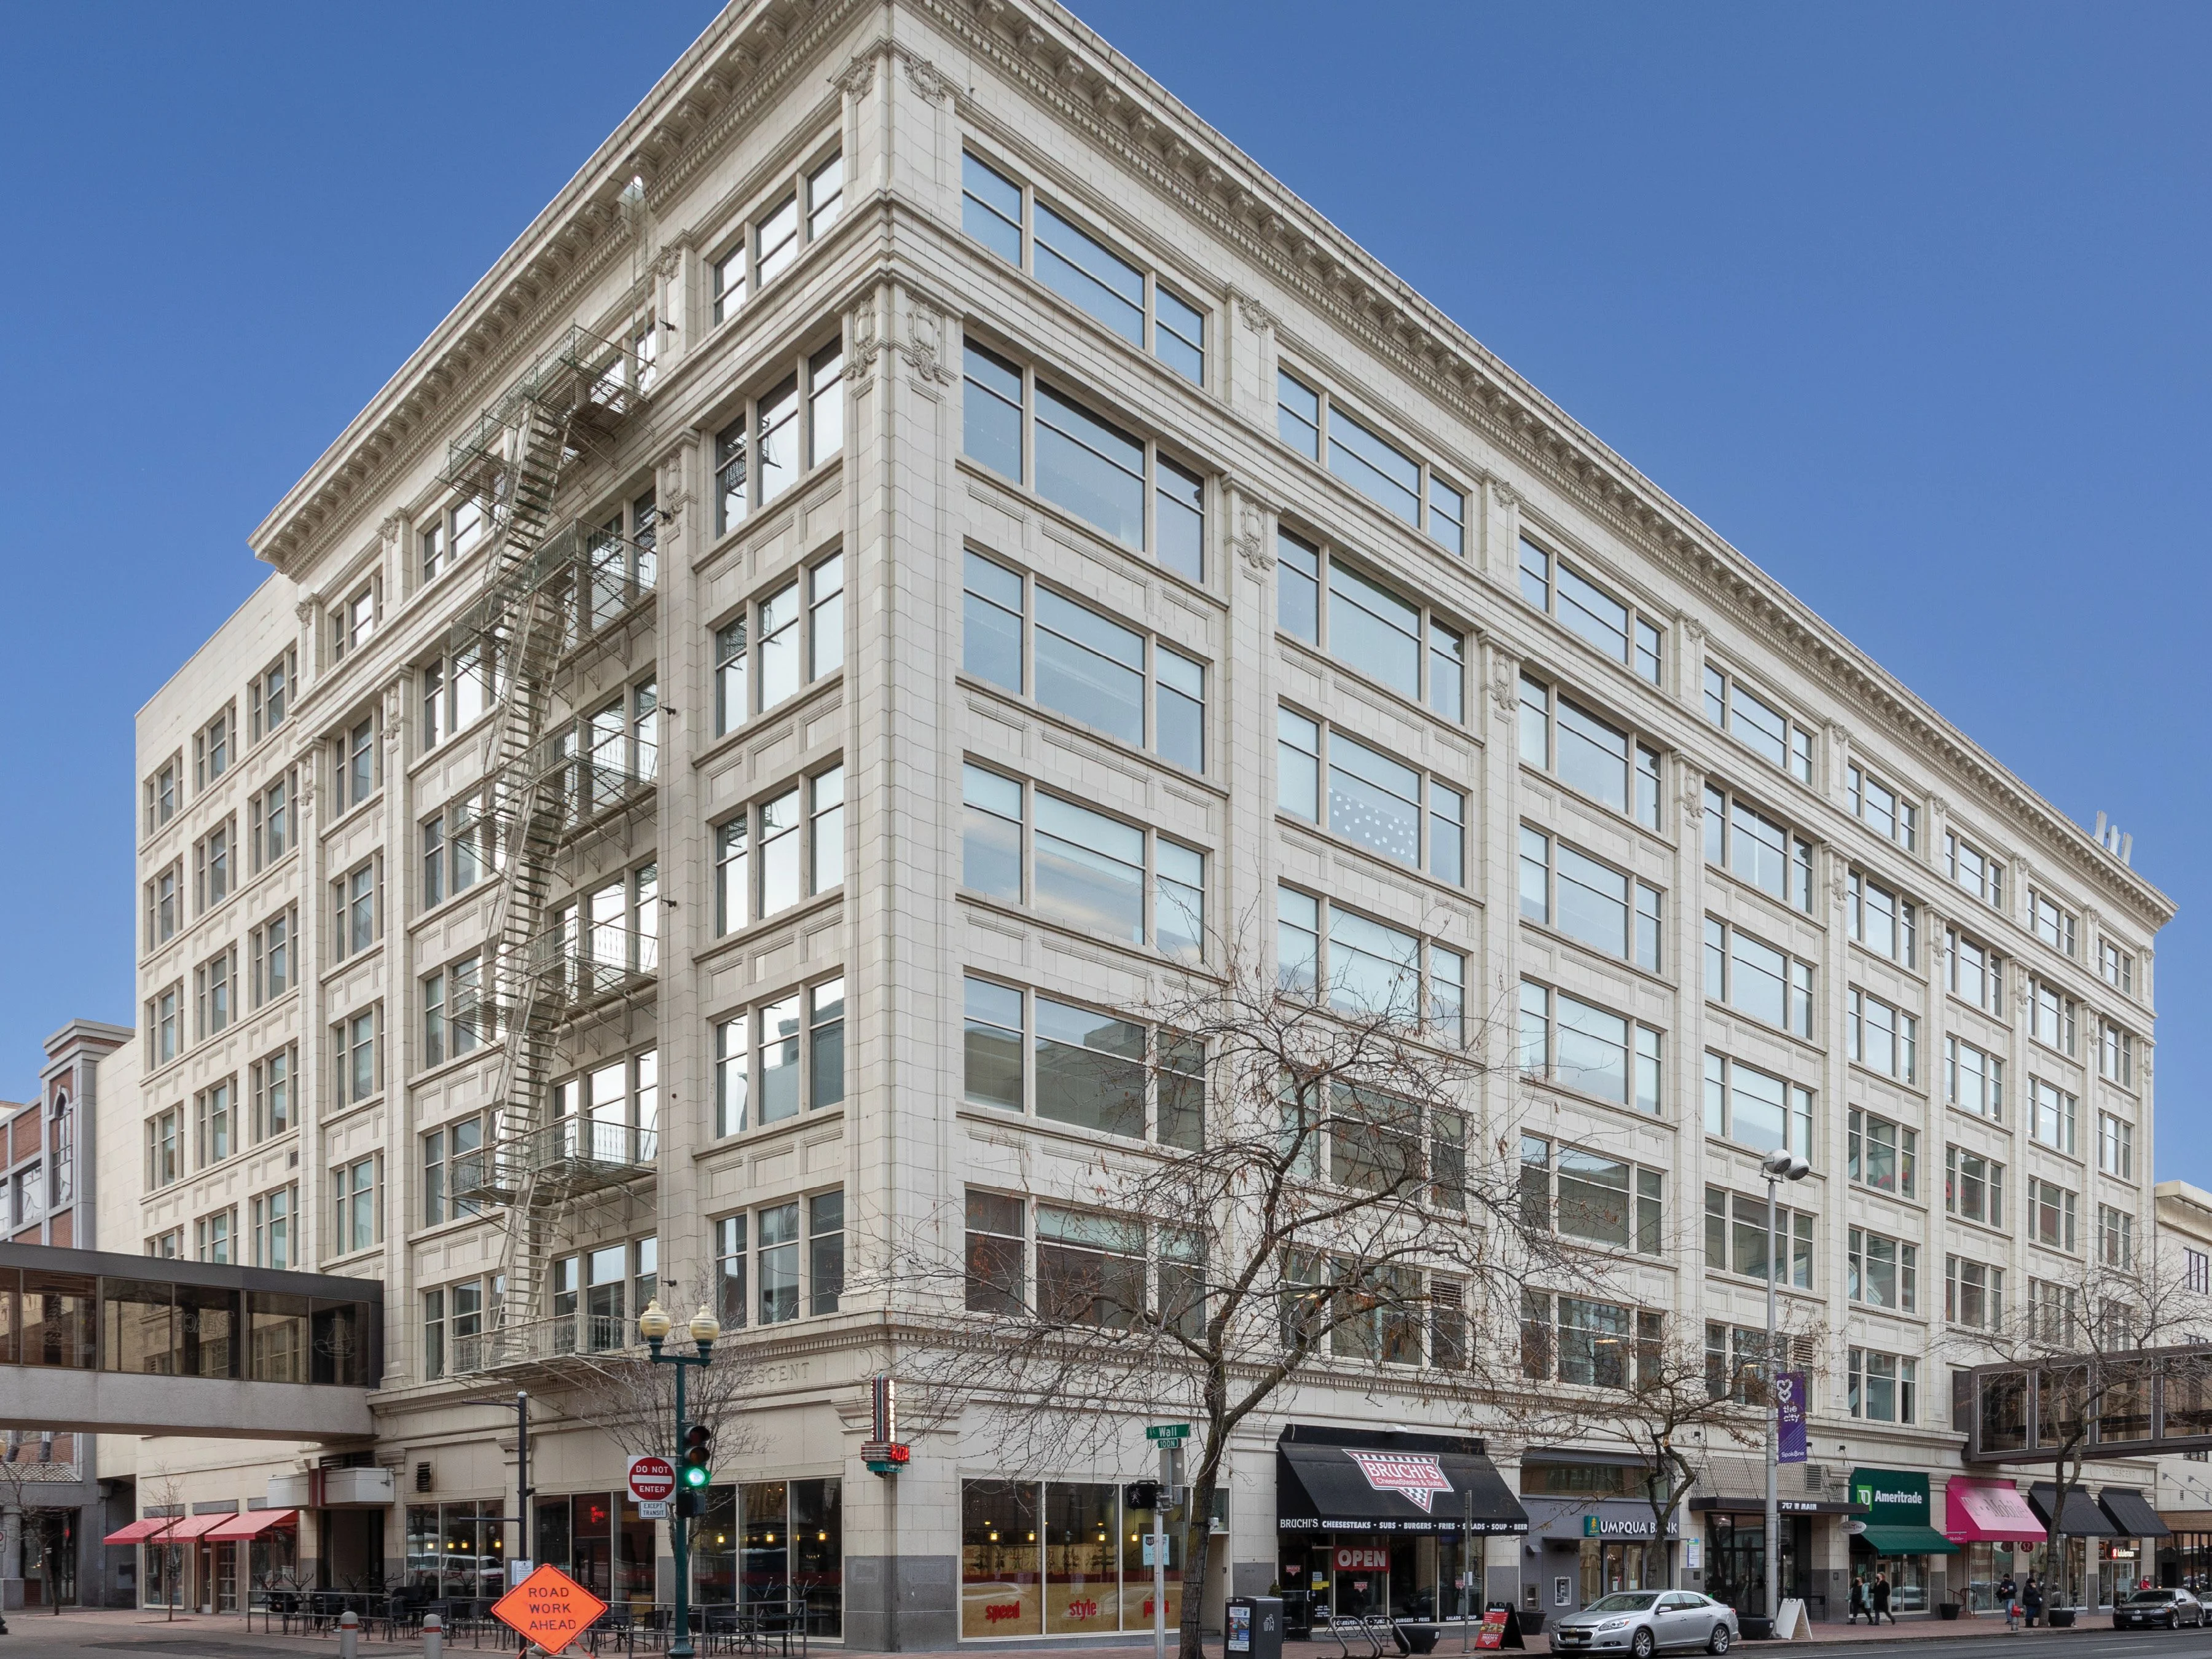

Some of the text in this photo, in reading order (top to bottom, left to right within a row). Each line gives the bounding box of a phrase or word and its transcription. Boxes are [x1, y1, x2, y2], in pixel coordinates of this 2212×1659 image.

[1783, 1405, 1797, 1413] the
[1783, 1414, 1800, 1422] city
[1159, 1426, 1177, 1437] Wall
[1364, 1462, 1439, 1480] BRUCHI'S
[1875, 1490, 1923, 1504] Ameritrade
[1280, 1518, 1319, 1528] BRUCHI'S
[1600, 1521, 1677, 1534] UMPQUA BNK
[1338, 1550, 1386, 1567] OPEN
[528, 1587, 570, 1598] ROAD
[529, 1603, 571, 1614] WORK
[986, 1601, 1020, 1623] speed
[1069, 1599, 1097, 1621] style
[528, 1620, 576, 1631] AHEAD
